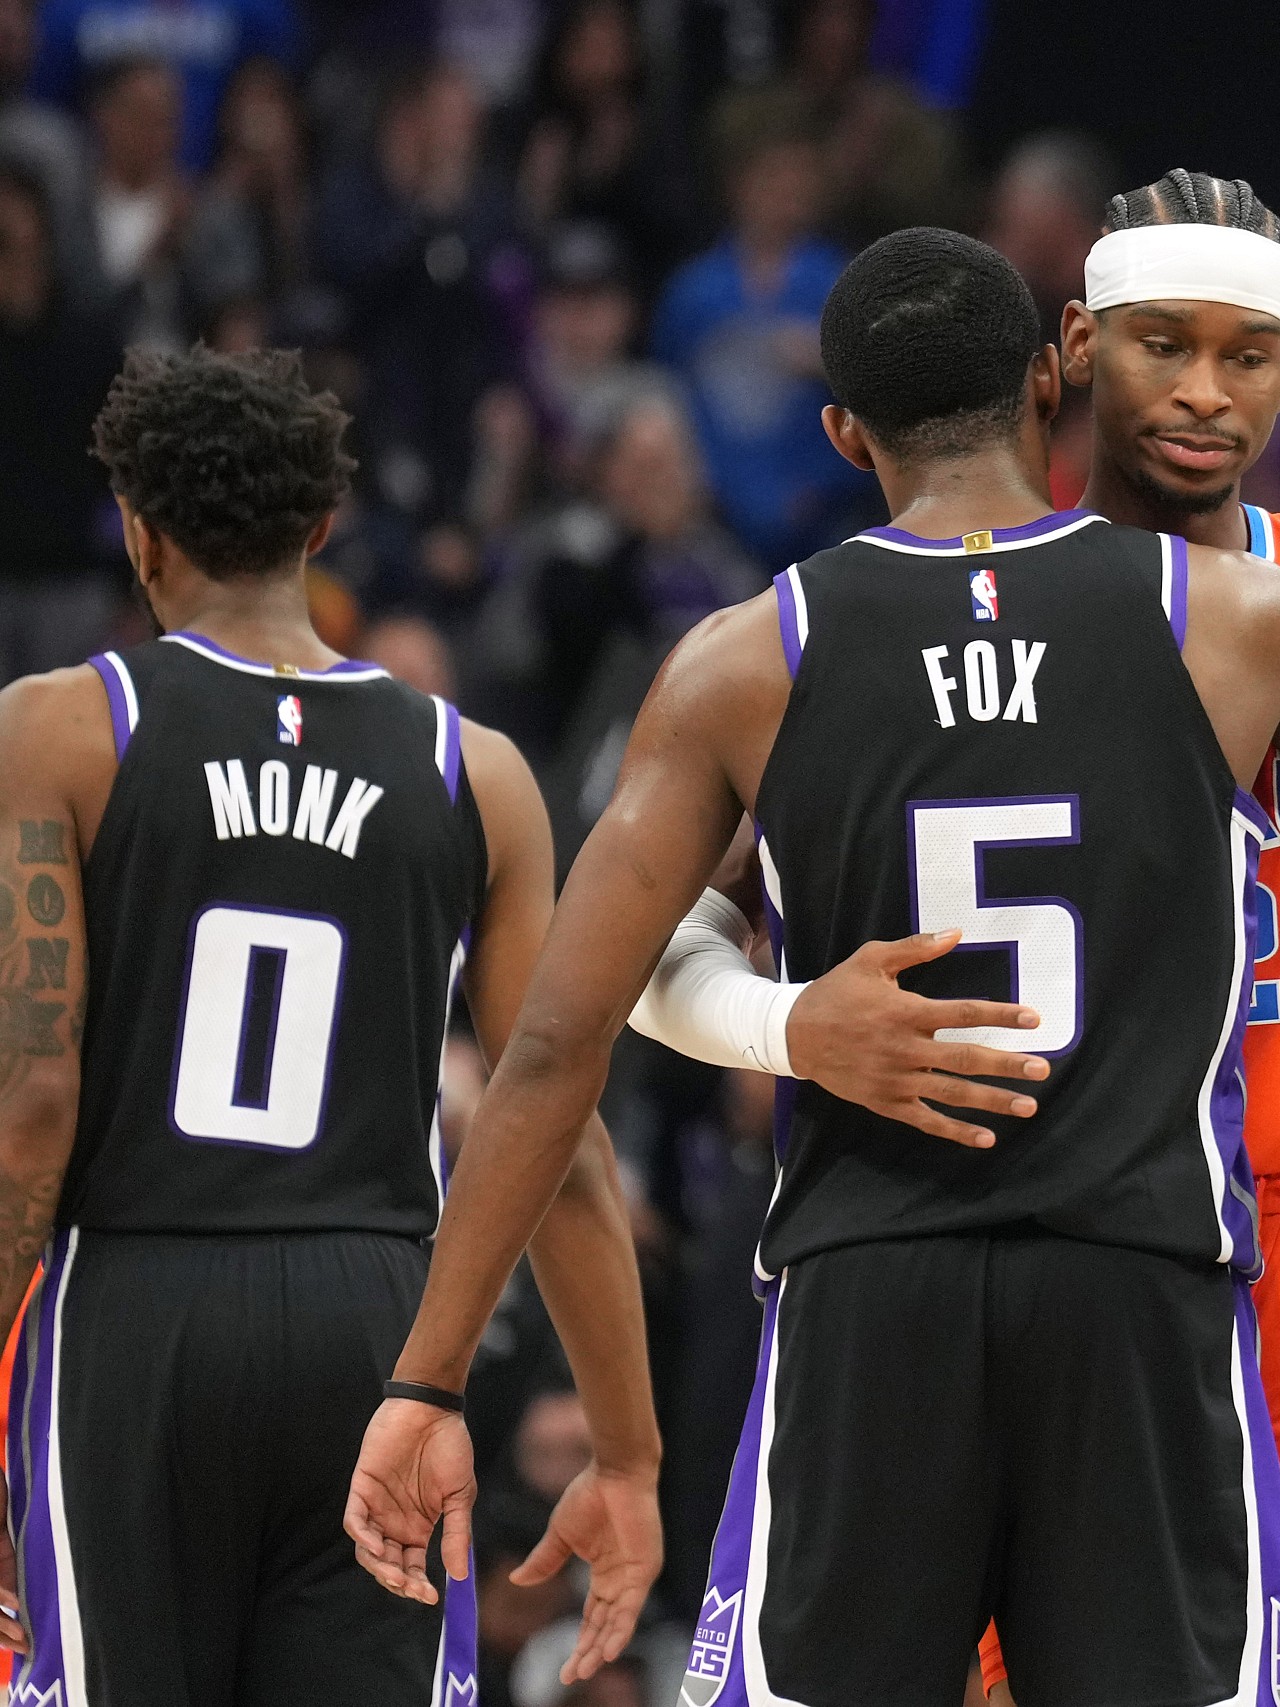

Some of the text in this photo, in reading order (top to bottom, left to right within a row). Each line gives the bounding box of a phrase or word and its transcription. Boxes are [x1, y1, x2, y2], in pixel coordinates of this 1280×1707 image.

[975, 608, 990, 620] NBA
[920, 638, 1048, 729] FOX
[203, 758, 384, 860] MONK
[905, 794, 1084, 1058] 5
[170, 900, 349, 1155] 0
